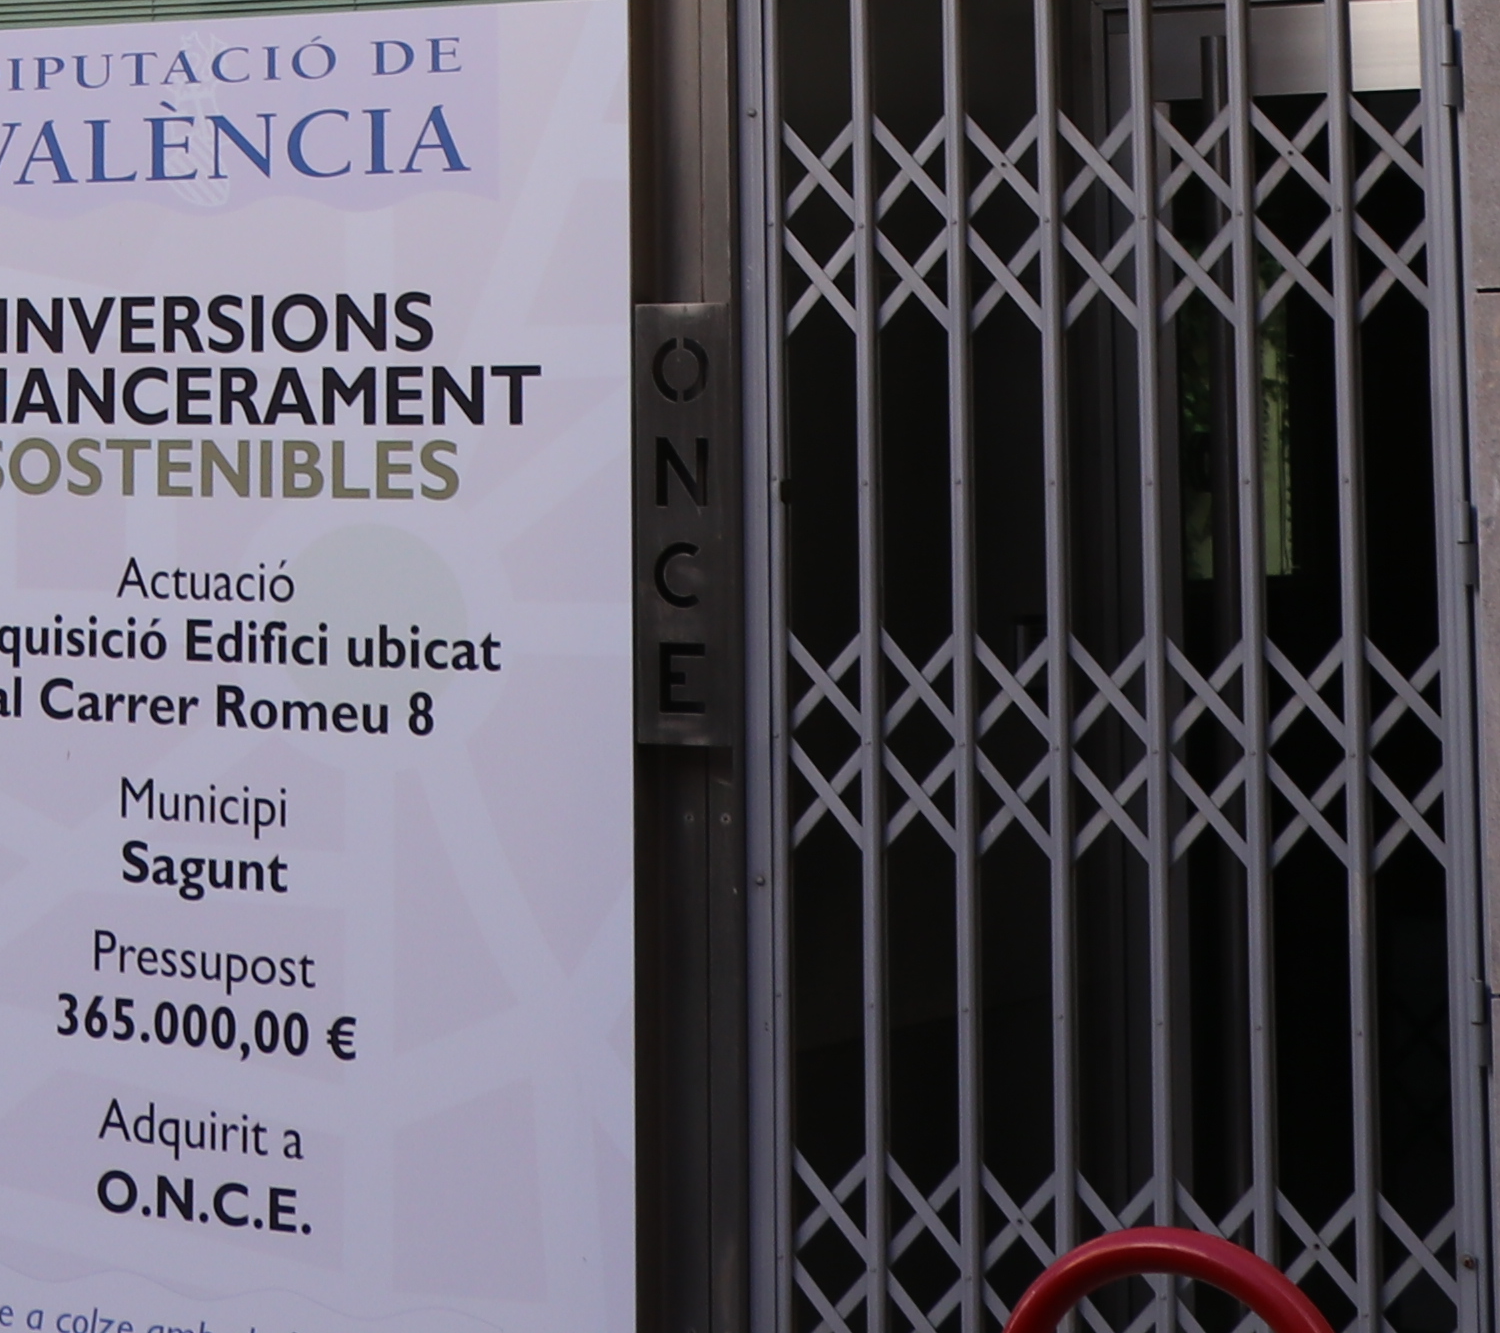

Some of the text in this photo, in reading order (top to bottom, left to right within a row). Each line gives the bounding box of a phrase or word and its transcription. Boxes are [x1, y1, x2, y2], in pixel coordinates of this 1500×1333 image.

[371, 37, 462, 76] DE
[652, 337, 709, 714] ONCE
[117, 556, 295, 603] Actuació
[186, 618, 328, 666] Edifici
[347, 624, 501, 672] ubicat
[40, 677, 200, 726] Carrer
[216, 684, 389, 734] Romeu
[408, 691, 434, 736] 8
[121, 776, 286, 840] Municipi
[122, 840, 288, 901] Sagunt
[94, 929, 316, 994] Pressupost
[57, 993, 357, 1061] 365.000,00 €
[98, 1098, 304, 1161] Adquirit a
[97, 1169, 312, 1235] O.N.C.E.
[26, 1309, 44, 1331] a
